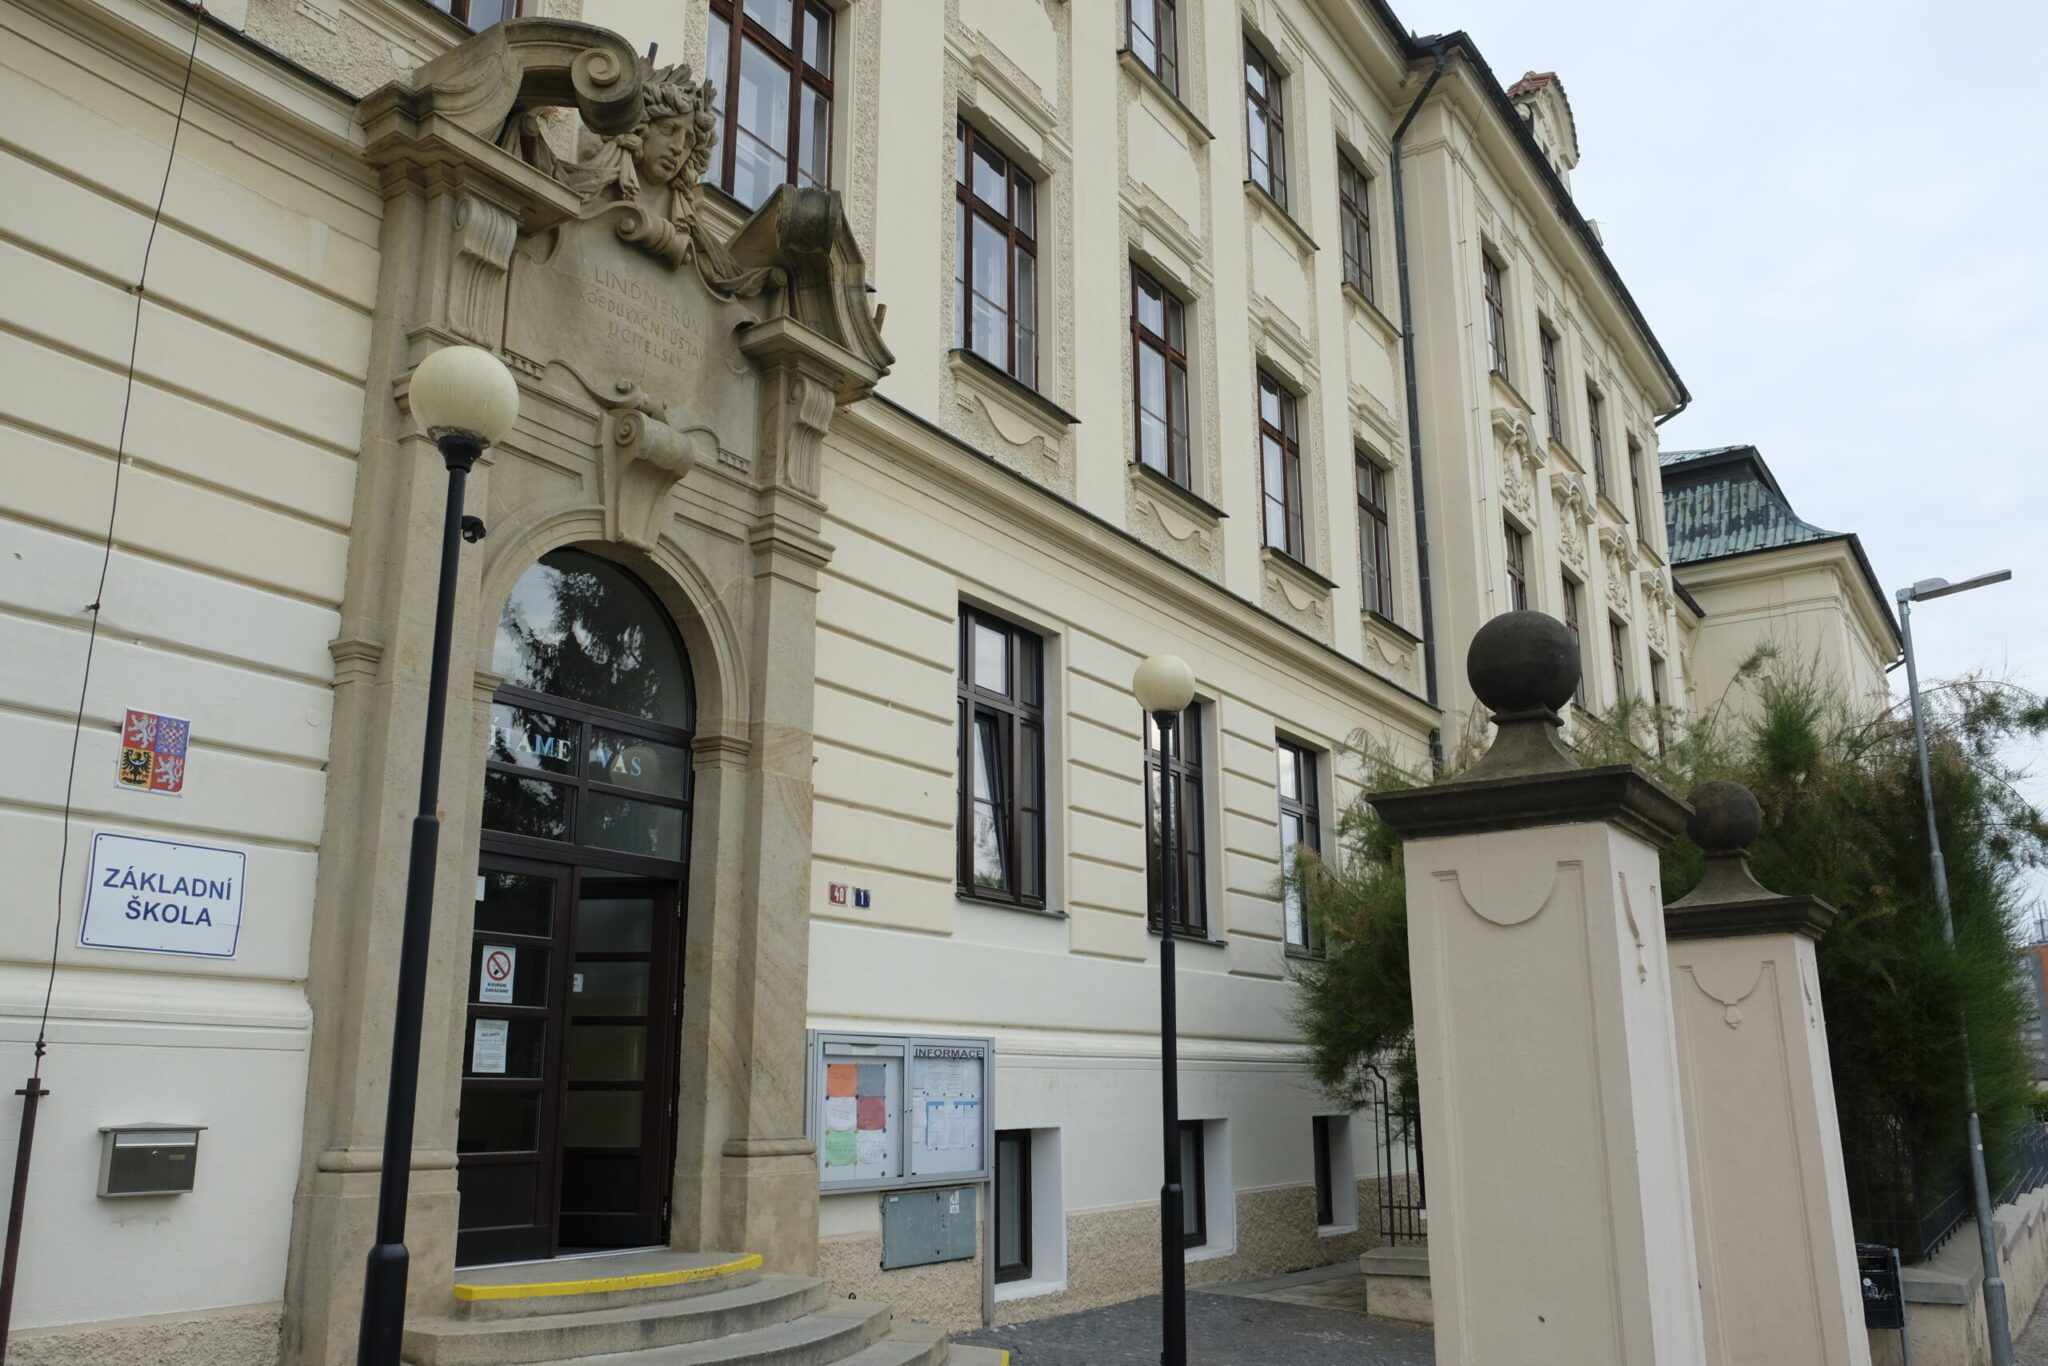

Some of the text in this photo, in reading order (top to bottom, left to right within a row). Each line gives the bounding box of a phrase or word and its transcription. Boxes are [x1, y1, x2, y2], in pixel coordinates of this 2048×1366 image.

[598, 743, 642, 777] VÁS
[103, 866, 233, 901] ZÁKLADNÍ
[125, 894, 213, 927] ŠKOLA
[914, 1048, 984, 1059] INFORMACE
